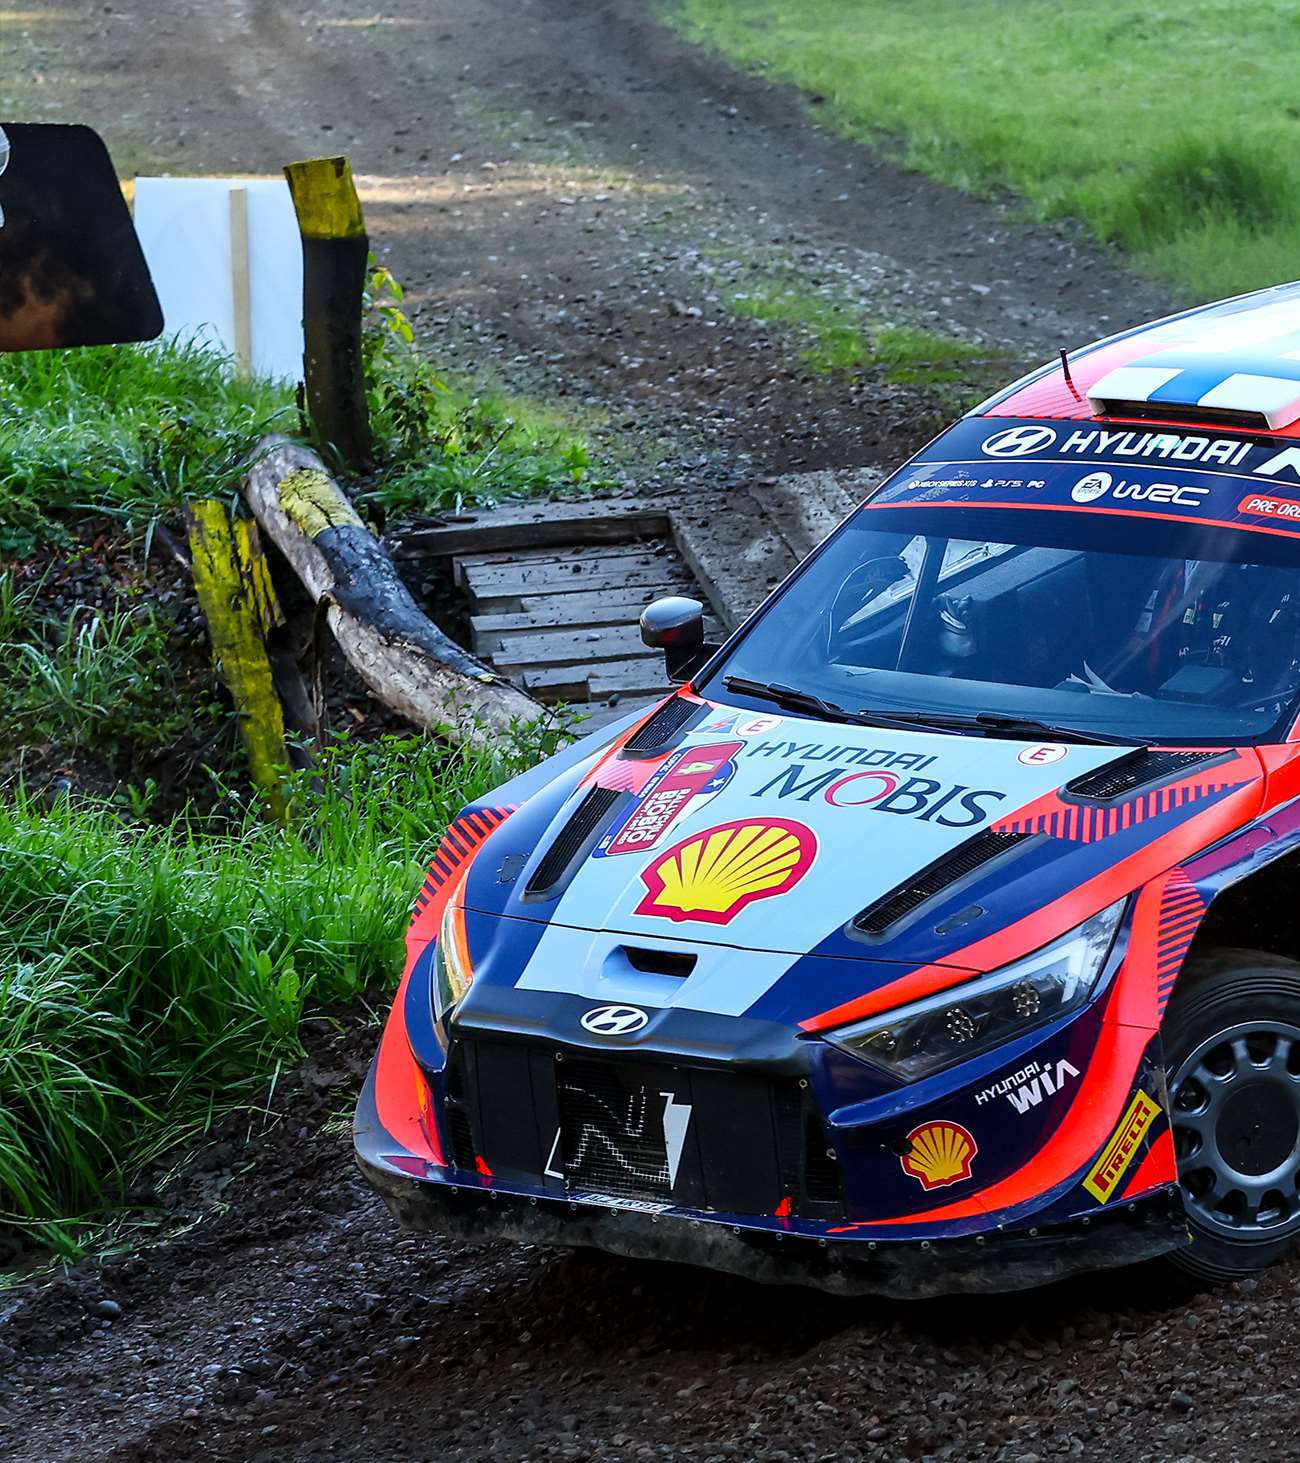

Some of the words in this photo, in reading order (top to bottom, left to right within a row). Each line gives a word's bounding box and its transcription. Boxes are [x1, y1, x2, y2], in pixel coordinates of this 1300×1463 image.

[1060, 430, 1253, 466] HYUNDAI
[1112, 480, 1209, 507] WRC
[1246, 498, 1274, 516] PRE
[747, 741, 938, 771] HYUNDAI
[750, 765, 1006, 828] MOBIS
[975, 1062, 1040, 1105] HYUNDAI
[1092, 1100, 1150, 1192] PIRELLI
